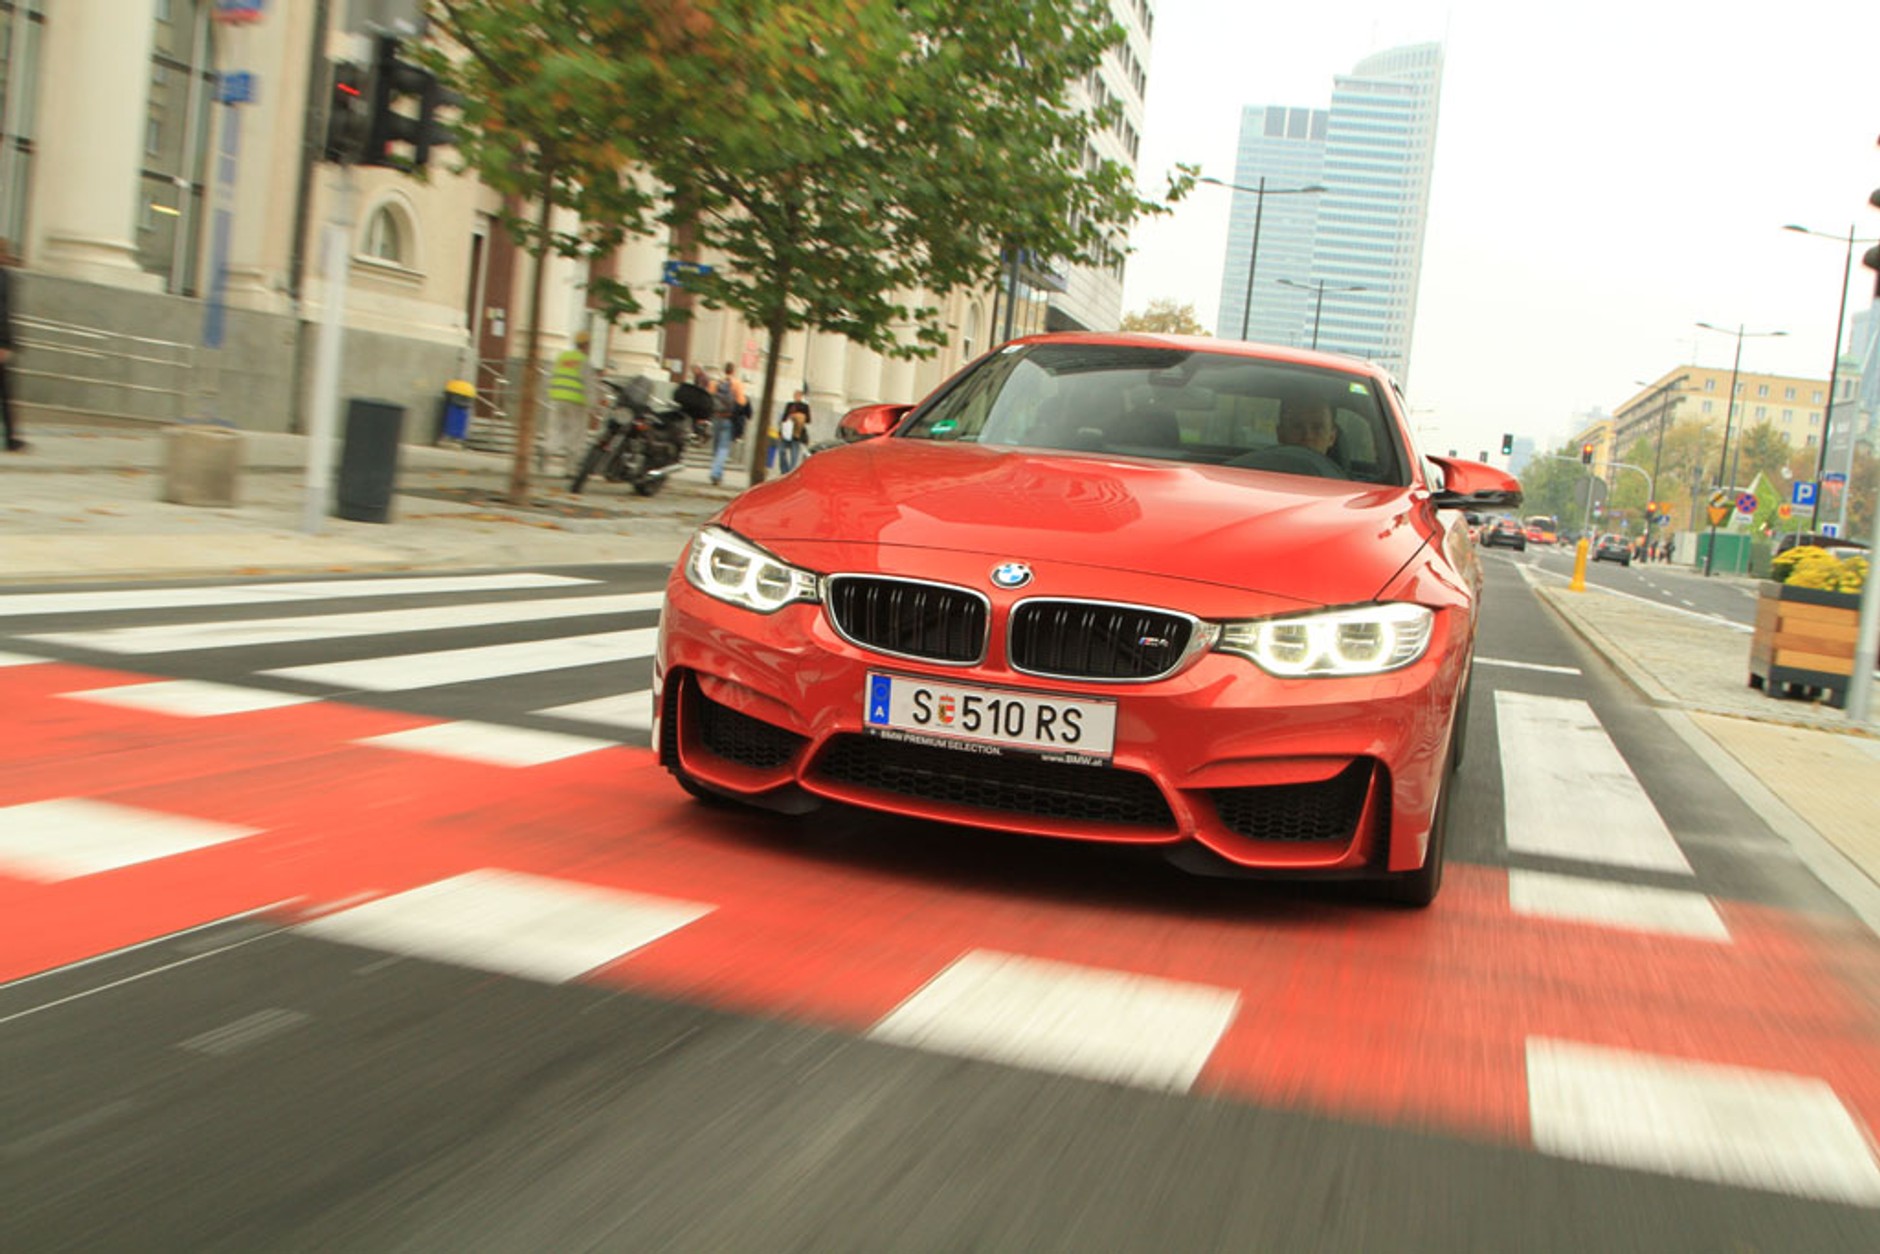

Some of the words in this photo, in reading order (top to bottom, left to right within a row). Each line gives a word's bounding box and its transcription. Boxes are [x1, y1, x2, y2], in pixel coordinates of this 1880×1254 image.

[1797, 484, 1813, 502] P
[874, 706, 885, 718] A
[912, 689, 932, 724] S
[961, 695, 1025, 737] 510
[1035, 703, 1082, 744] RS
